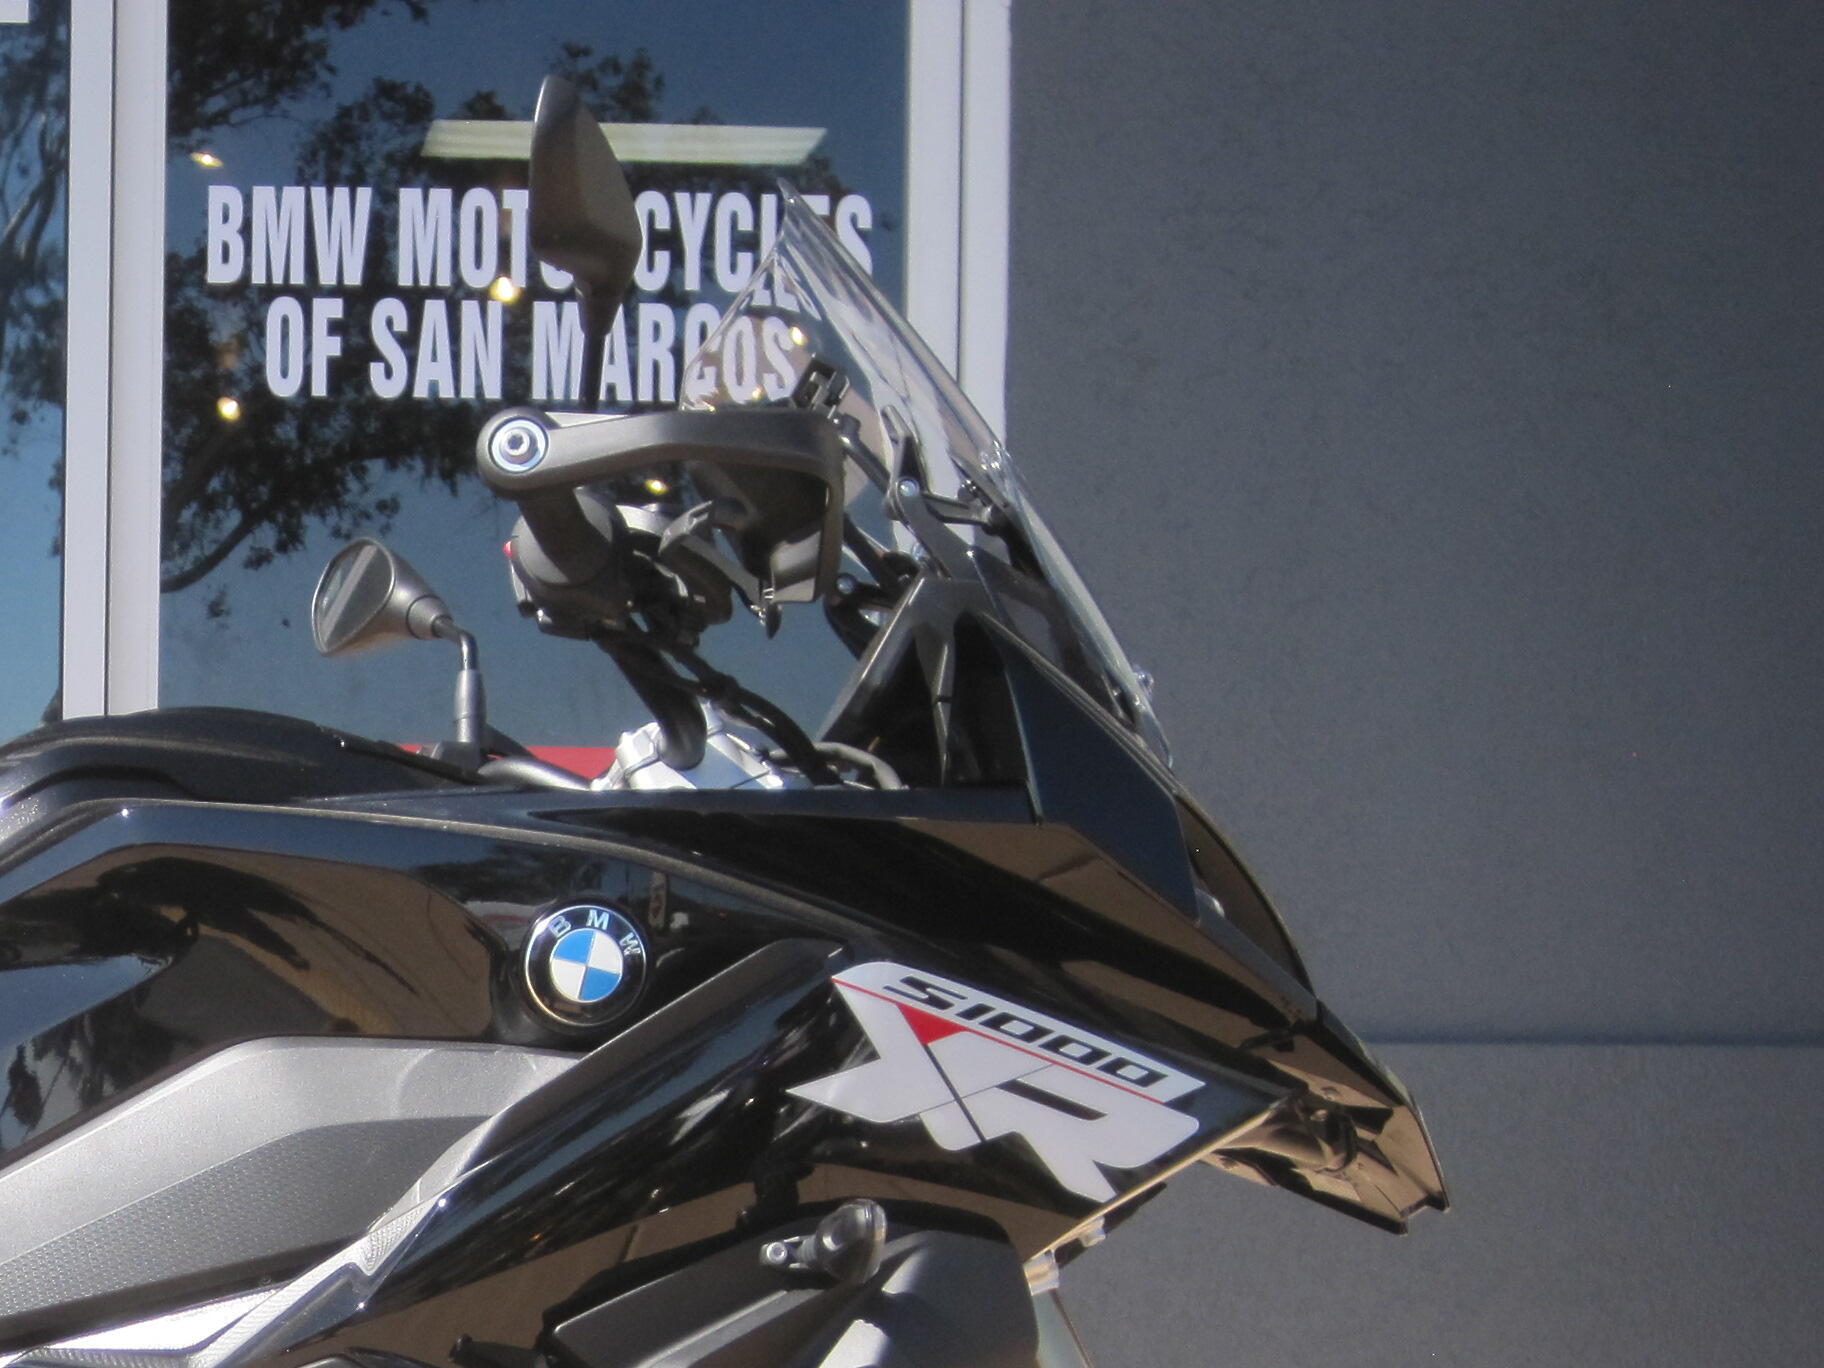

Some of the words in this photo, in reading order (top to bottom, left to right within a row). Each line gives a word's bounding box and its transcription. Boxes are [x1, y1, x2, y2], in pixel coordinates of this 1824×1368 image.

[205, 185, 373, 287] BMW
[398, 187, 874, 293] MOTCYCLS
[264, 297, 344, 398] OF
[369, 297, 503, 400] SAN
[548, 909, 641, 956] BMW
[883, 976, 1169, 1088] S1000
[786, 977, 1200, 1203] XR
